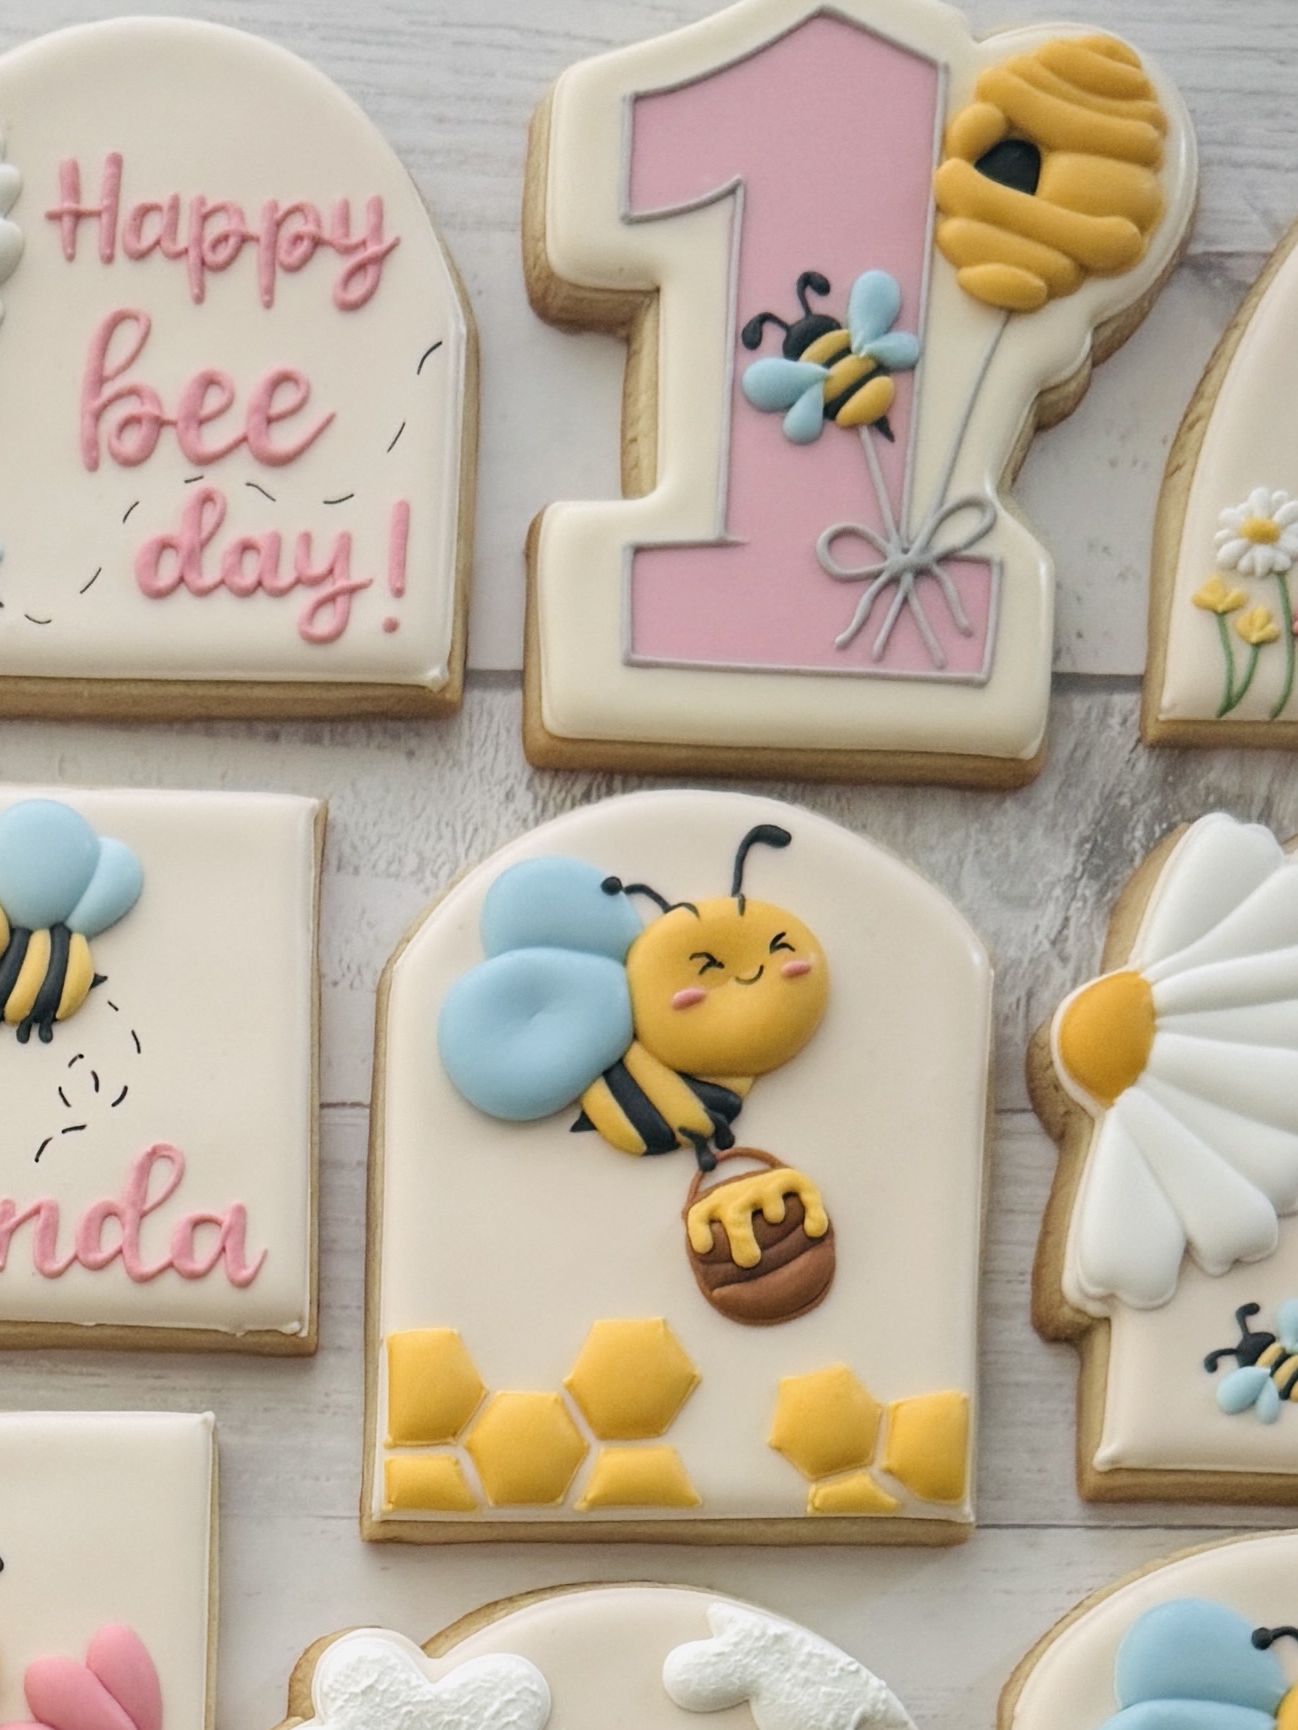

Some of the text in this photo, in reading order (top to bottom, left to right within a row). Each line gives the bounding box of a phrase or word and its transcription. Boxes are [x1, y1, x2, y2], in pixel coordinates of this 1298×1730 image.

[45, 152, 401, 311] Happy
[81, 308, 336, 471] bee
[135, 486, 410, 644] day!
